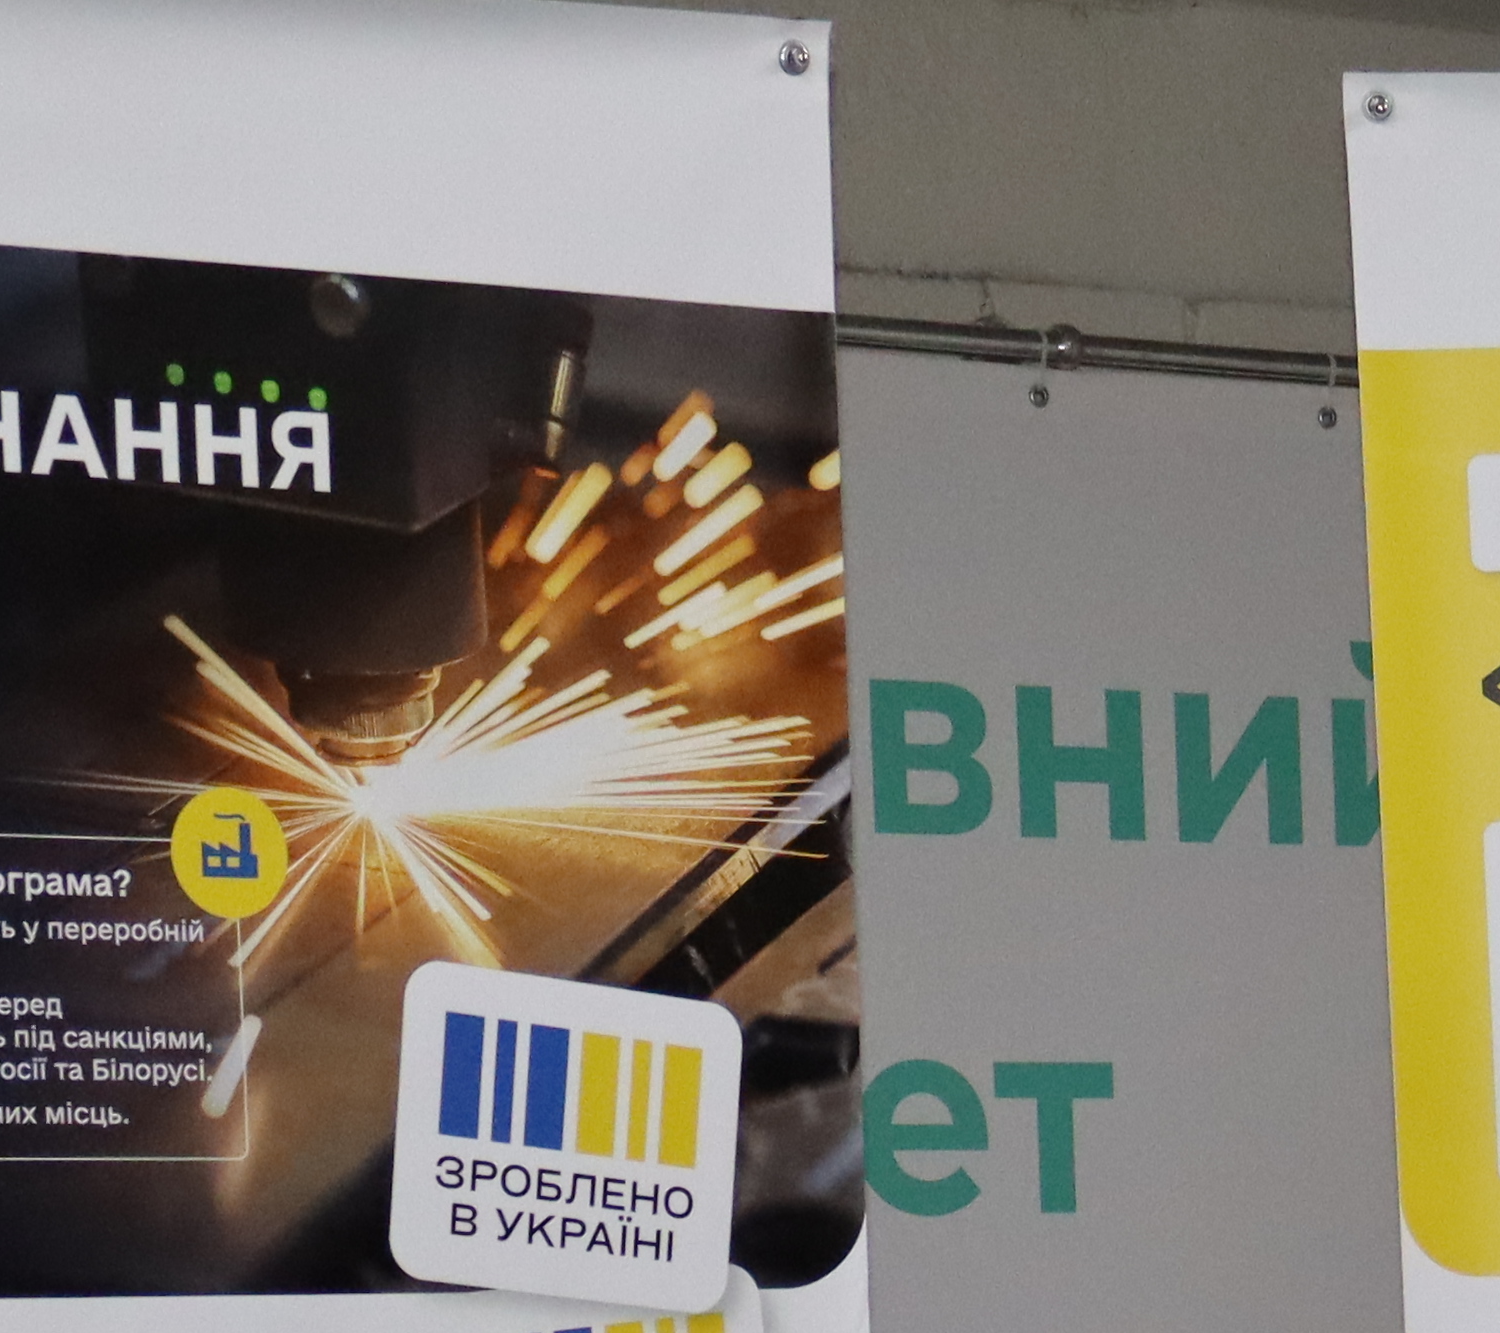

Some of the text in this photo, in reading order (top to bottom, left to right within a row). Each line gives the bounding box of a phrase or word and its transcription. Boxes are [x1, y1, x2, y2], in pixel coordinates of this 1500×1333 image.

[45, 1101, 129, 1128] місць.
[436, 1155, 693, 1222] ЗРОБЛЕНО
[451, 1203, 673, 1262] В УКРАЇНІ
